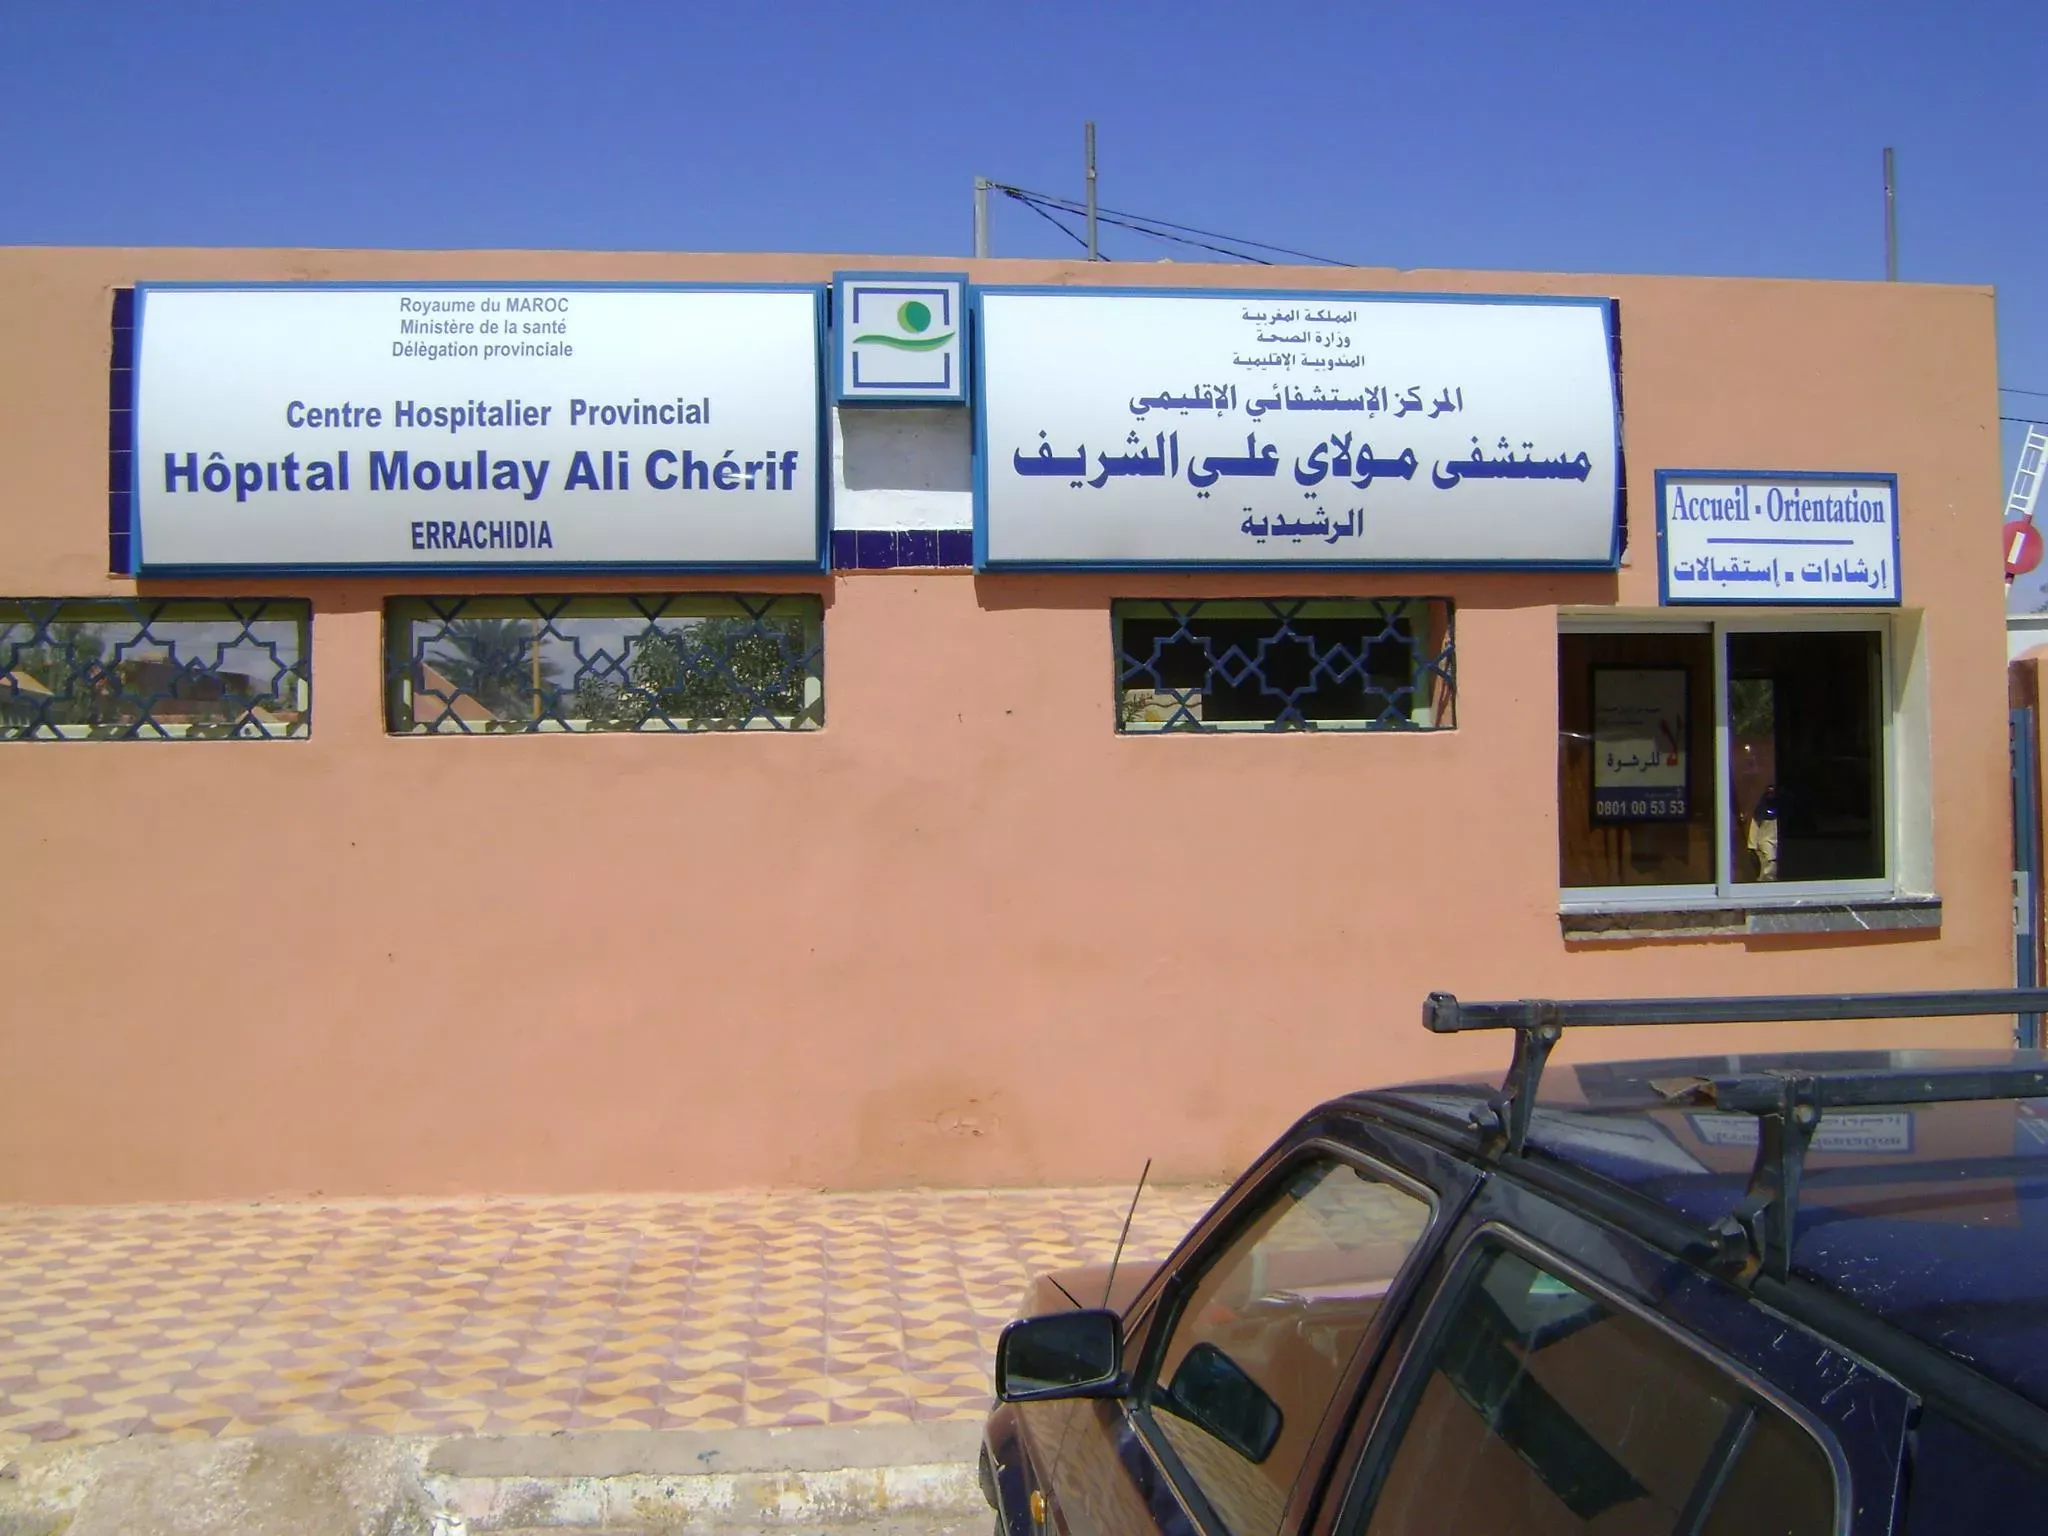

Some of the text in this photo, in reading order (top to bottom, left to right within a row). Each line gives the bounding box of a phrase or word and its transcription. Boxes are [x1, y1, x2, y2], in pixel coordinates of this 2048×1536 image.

[400, 297, 568, 316] Royaume du MAROC
[1242, 308, 1356, 325] المملكة المغربية
[401, 318, 566, 334] Ministère de la santé
[1257, 330, 1350, 348] وزارة الصحة
[484, 341, 572, 360] provinciale
[1233, 352, 1364, 371] المندوبية الإقليمية
[287, 398, 709, 434] Centre Hospitalier Provincial
[1129, 384, 1236, 421] الإقليمي
[1393, 386, 1463, 419] المركز
[370, 450, 550, 500] Moulay
[564, 451, 628, 490] Ali
[645, 449, 798, 490] Chérif
[1014, 430, 1178, 489] الشريف
[1188, 432, 1279, 499] علي
[1432, 436, 1592, 489] مستشفى
[1671, 484, 1886, 523] Accueil Orientation
[412, 521, 552, 549] ERRACHIDIA
[1241, 507, 1363, 544] الرشيدية
[1674, 557, 1887, 589] إرشادات إستقبالات
[1631, 800, 1646, 816] 00
[1650, 800, 1666, 816] 53
[1669, 800, 1686, 816] 53
